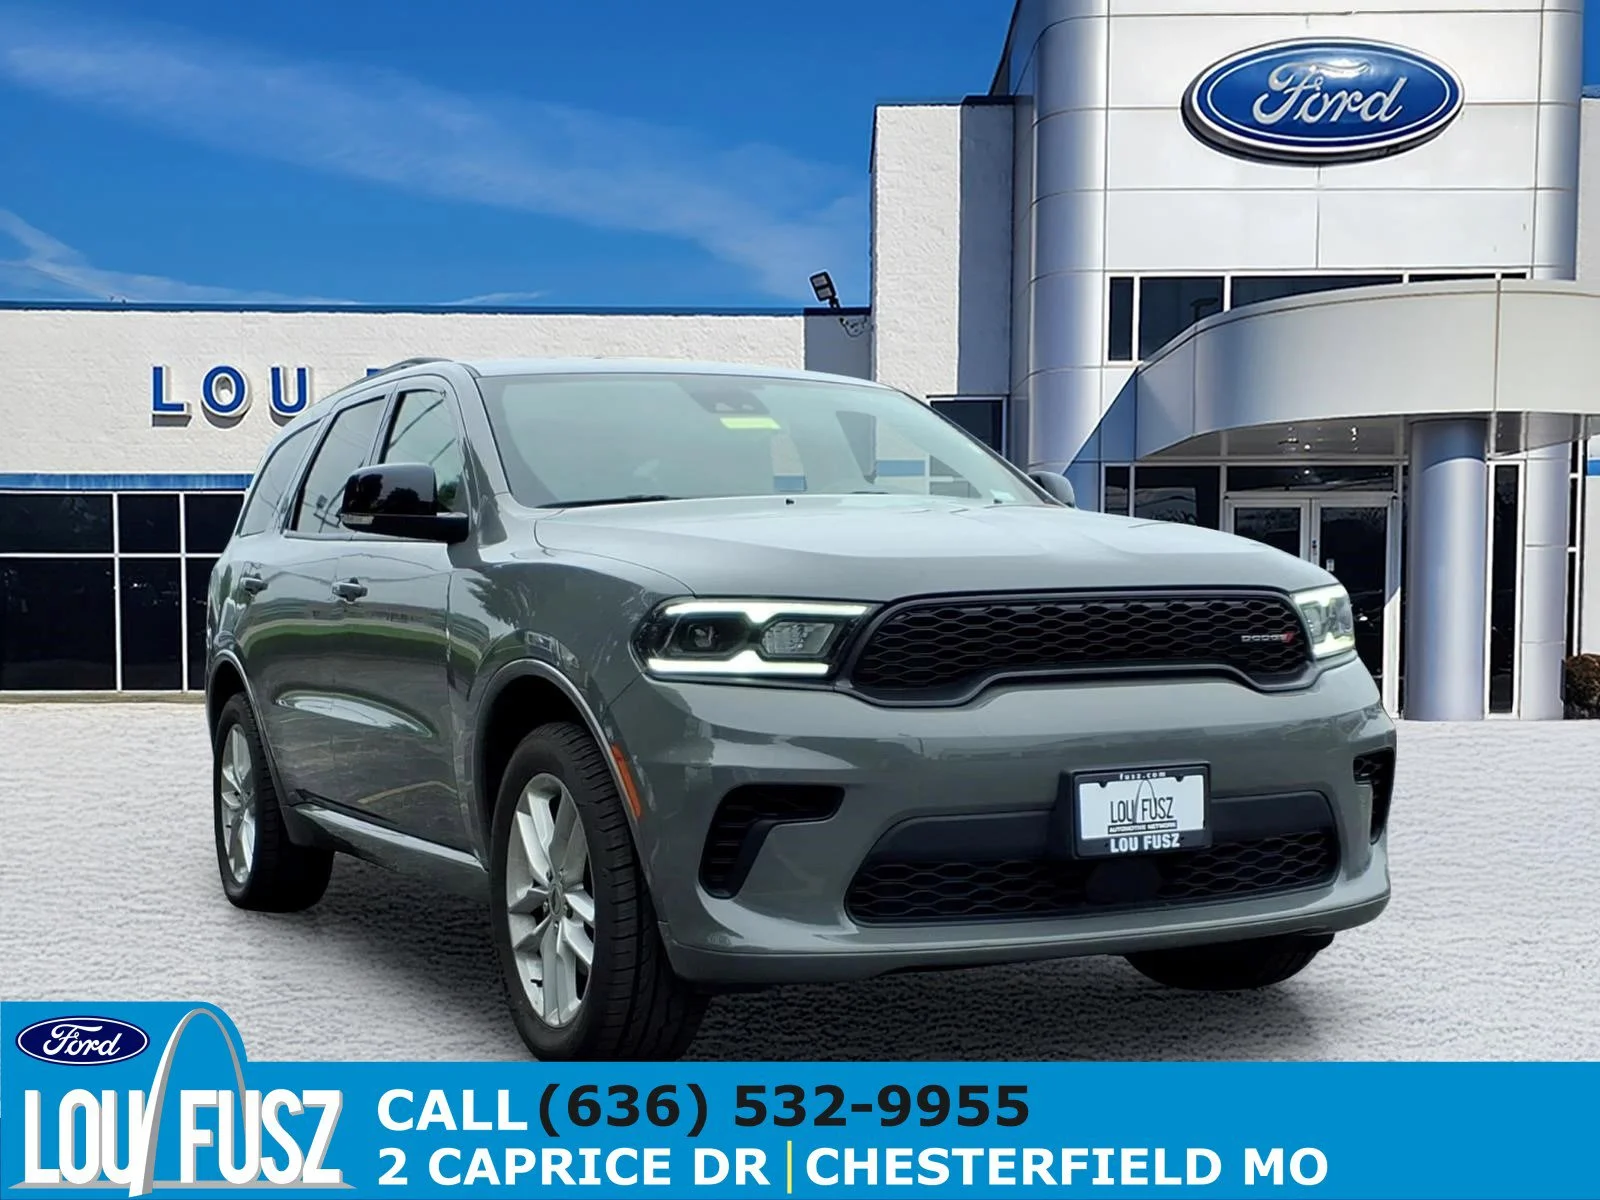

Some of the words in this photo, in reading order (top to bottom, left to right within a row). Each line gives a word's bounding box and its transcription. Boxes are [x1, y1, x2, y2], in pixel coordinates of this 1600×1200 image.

[1252, 61, 1407, 124] Ford
[151, 363, 313, 415] LOU
[1241, 633, 1288, 643] DODGE
[1120, 772, 1167, 780] fusz.com
[1110, 799, 1134, 823] LOU
[1141, 797, 1174, 820] FUSZ
[1110, 836, 1139, 853] LOU
[1143, 832, 1180, 850] FUSZ
